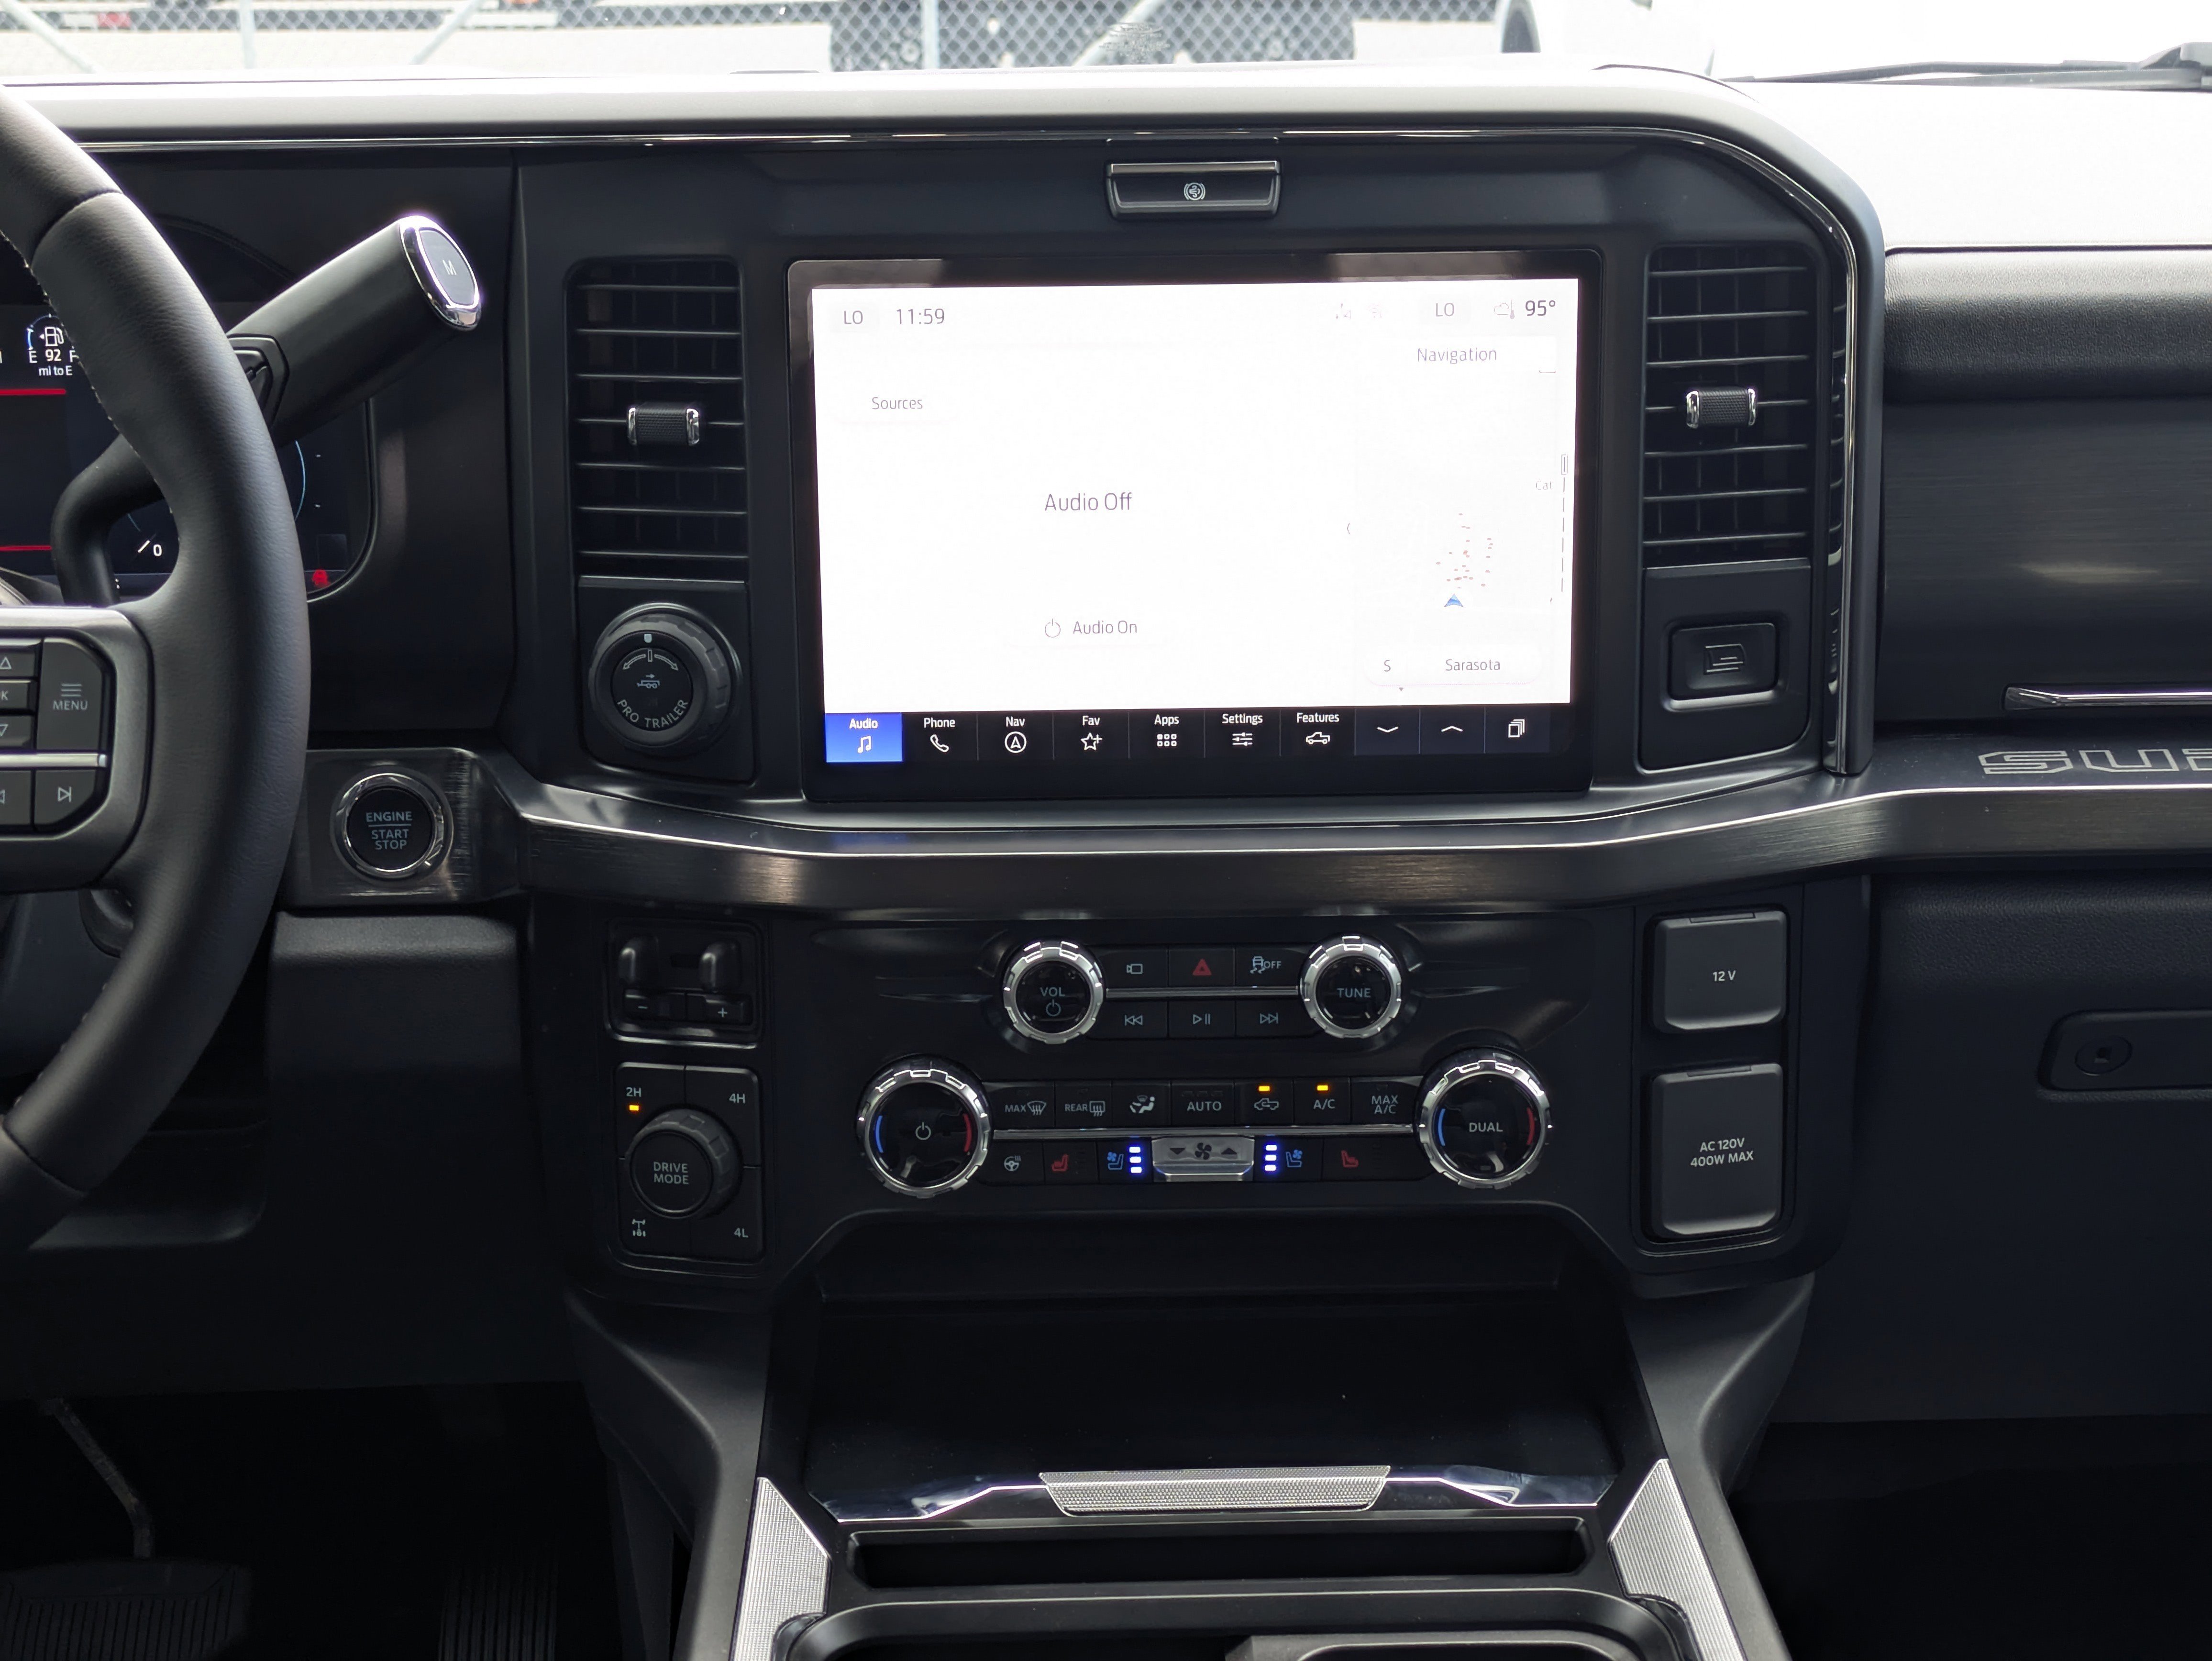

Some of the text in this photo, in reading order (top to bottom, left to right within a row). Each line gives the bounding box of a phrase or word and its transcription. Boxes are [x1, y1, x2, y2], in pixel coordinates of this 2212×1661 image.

[442, 259, 457, 276] M
[1436, 302, 1455, 317] LO
[843, 310, 863, 325] LO
[896, 308, 945, 325] 11:59
[28, 349, 79, 364] E 92 F
[1417, 347, 1497, 364] Navigation
[53, 365, 64, 376] to
[65, 365, 73, 376] E
[872, 397, 923, 410] Sources
[1044, 492, 1132, 511] Audio Off
[153, 544, 162, 556] 0
[1073, 620, 1137, 634] Audio On
[1384, 660, 1391, 672] S
[1446, 659, 1501, 671] Sarasota
[53, 700, 88, 710] MENU
[617, 699, 689, 729] PRO TRAILER
[1222, 713, 1263, 725] Settings
[1296, 712, 1339, 723] Features
[849, 717, 878, 729] Audio
[924, 717, 955, 728] Phone
[1006, 716, 1025, 727] Nav
[1082, 715, 1100, 726] Fav
[1154, 714, 1180, 727] Apps
[366, 811, 413, 822] ENGINE
[371, 829, 409, 840] START
[375, 839, 407, 850] STOP
[1263, 961, 1282, 970] OFF
[1713, 970, 1736, 982] 12 V
[1040, 986, 1066, 997] VOL
[1337, 987, 1371, 999] TUNE
[626, 1087, 641, 1097] 2H
[729, 1093, 745, 1104] 4H
[1313, 1098, 1335, 1110] A/C
[1371, 1095, 1399, 1105] MAX
[1005, 1104, 1026, 1113] MAX
[1065, 1104, 1088, 1112] REAR
[1187, 1101, 1222, 1111] AUTO
[1373, 1104, 1397, 1115] A/C
[1469, 1122, 1504, 1132] DUAL
[1700, 1137, 1745, 1152] AC 120V
[1690, 1150, 1754, 1167] 400W MAX
[653, 1162, 688, 1174] DRIVE
[653, 1174, 689, 1185] MODE
[734, 1228, 749, 1238] 4L
